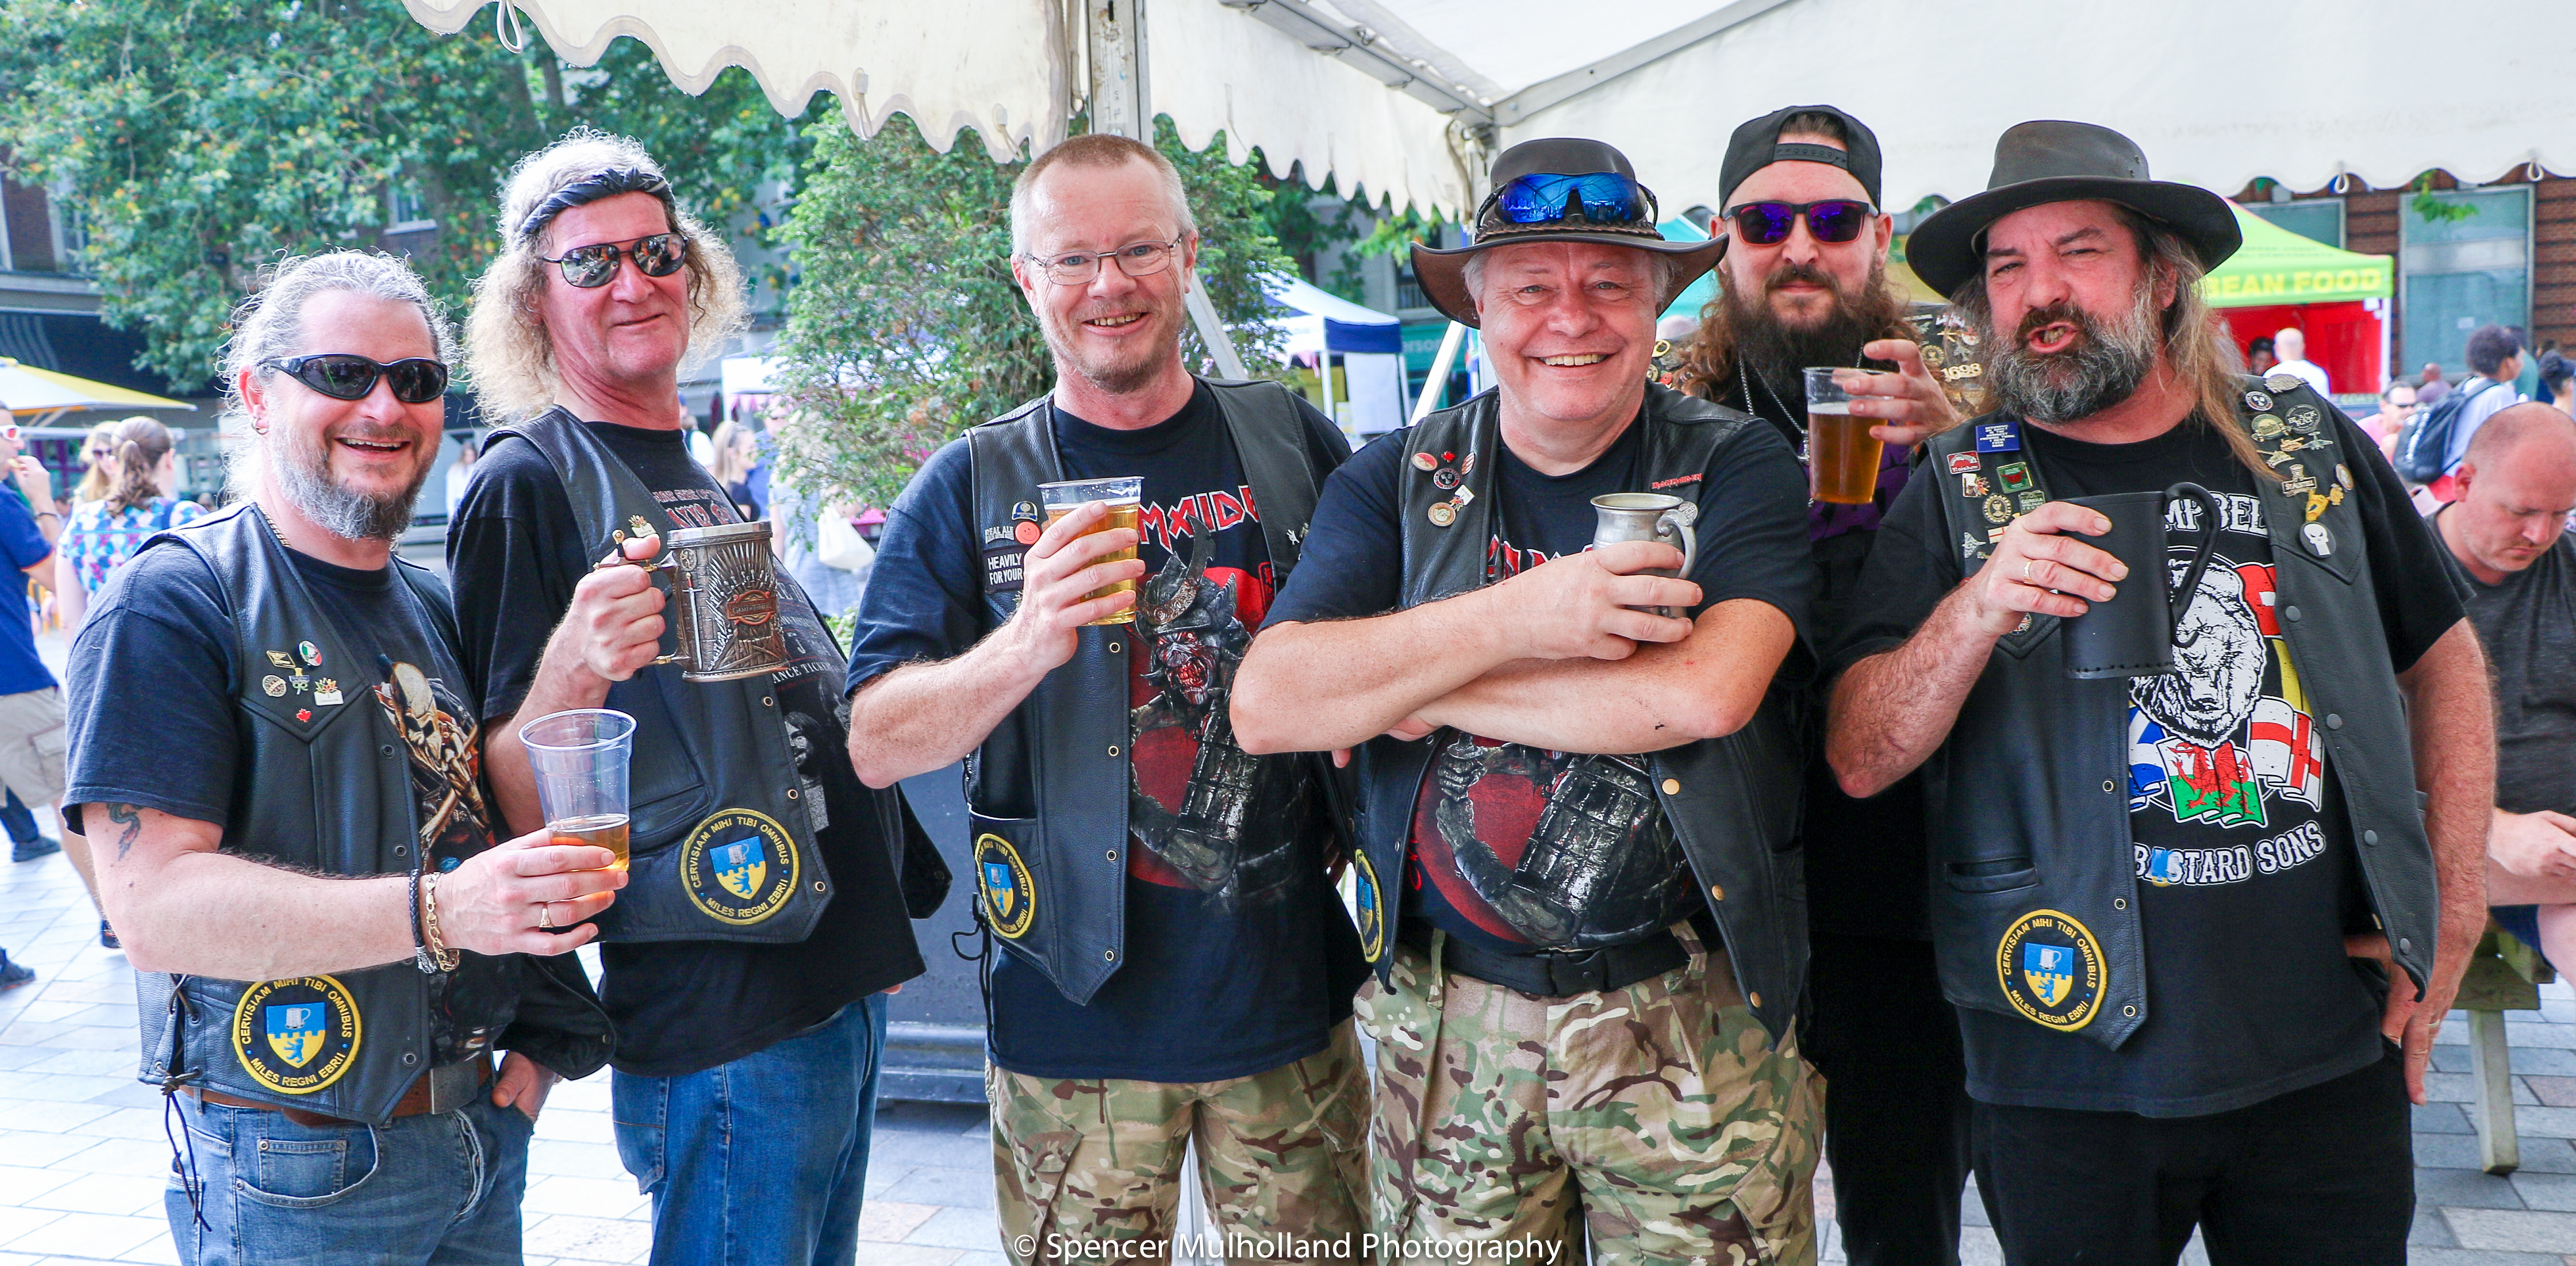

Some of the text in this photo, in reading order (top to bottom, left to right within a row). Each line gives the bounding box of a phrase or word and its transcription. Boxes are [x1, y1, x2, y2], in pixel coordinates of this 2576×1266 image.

[2294, 268, 2382, 293] FOOD
[1941, 363, 1982, 380] 1698
[985, 526, 1001, 536] REAL
[1137, 485, 1260, 554] MAIDE
[987, 553, 1022, 571] HEAVILY
[989, 568, 1023, 586] FOR YOUR
[772, 666, 802, 684] ANCE
[689, 816, 790, 888] CERVISIAM MIHI TIBI OMNIBUS
[2134, 821, 2326, 884] BSTARD SONS
[706, 879, 789, 917] MILES REGNI EBRII
[2003, 918, 2096, 988] CERVISIAM MIHI TIBI OMNIBUS
[240, 977, 353, 1044] CERVISIAM MIHI TIBI OMNIBUS
[2011, 990, 2089, 1023] MILES REGNI EBRII
[250, 1052, 346, 1087] MILES REGNI EBRII
